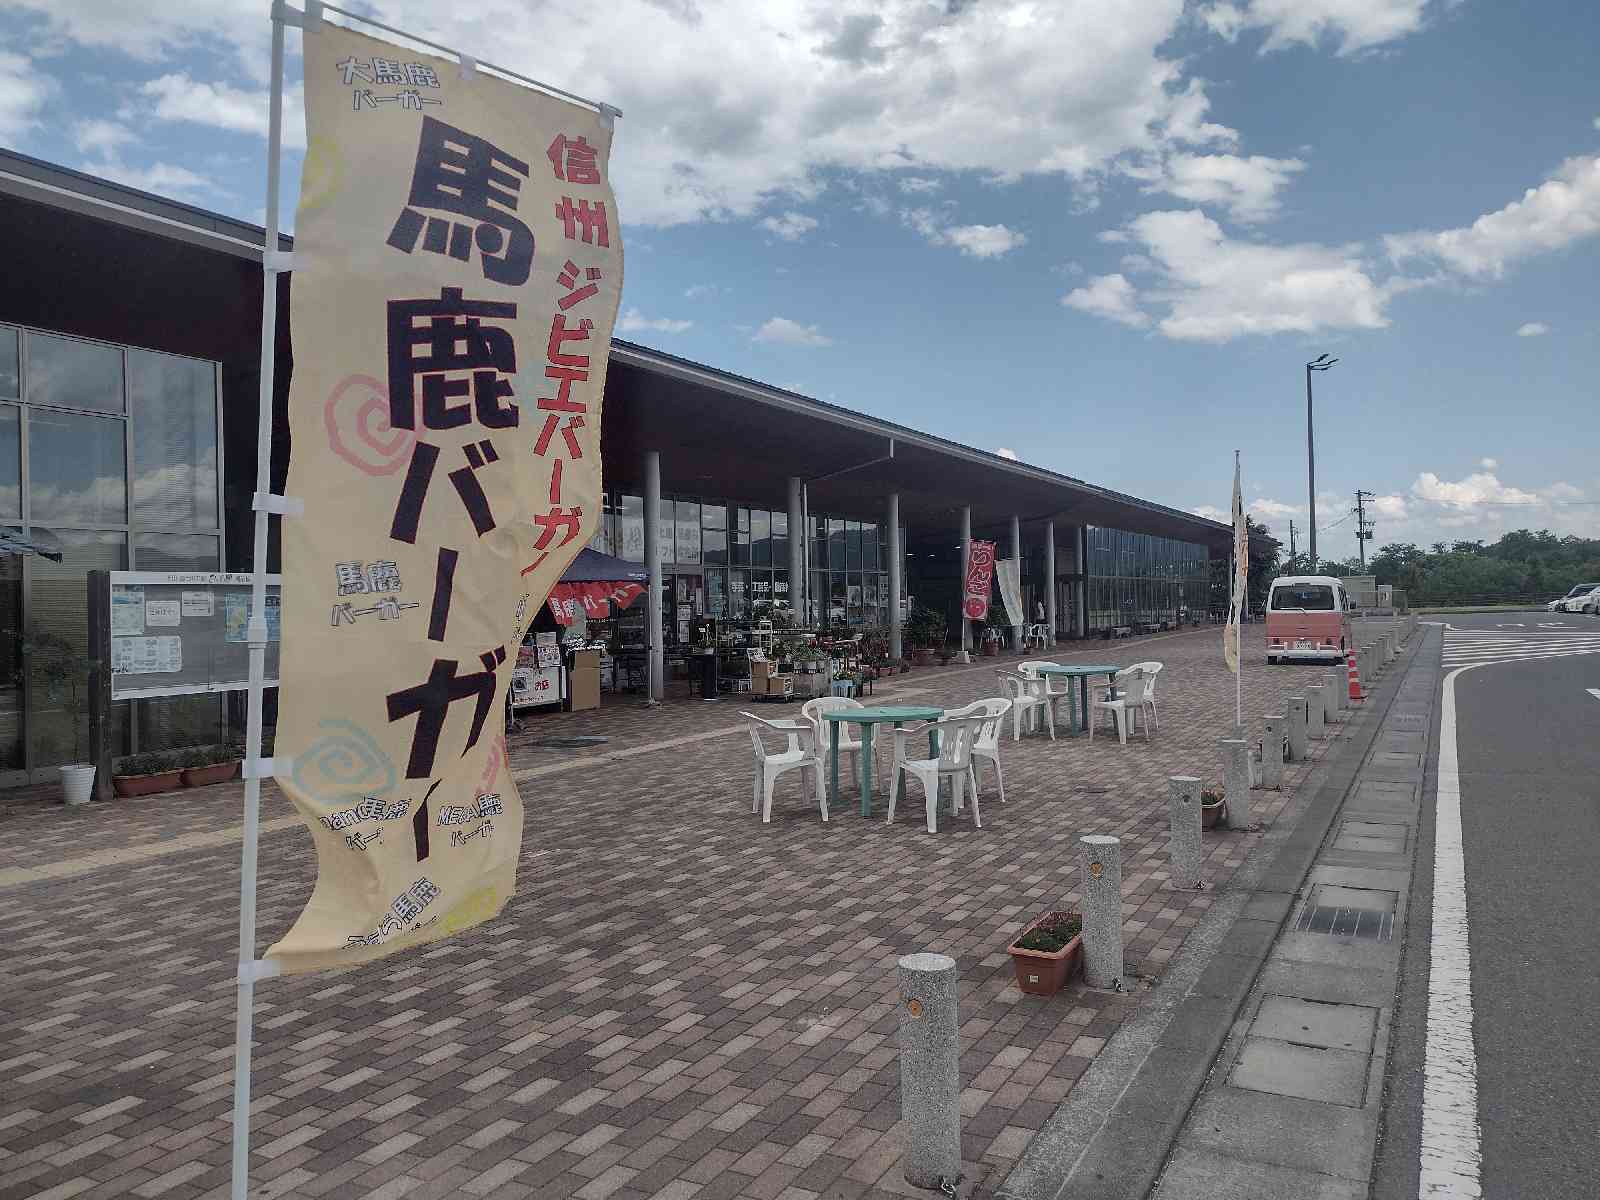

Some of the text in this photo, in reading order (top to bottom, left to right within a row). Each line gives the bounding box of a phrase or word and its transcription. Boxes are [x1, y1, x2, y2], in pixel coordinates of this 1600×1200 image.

[335, 56, 441, 88] 大馬鹿
[352, 89, 443, 111] バーガー
[520, 133, 610, 577] 信州ジビエバーガー
[385, 114, 536, 863] 馬鹿バーガー
[335, 560, 401, 596] 馬鹿
[331, 597, 420, 626] バーガー
